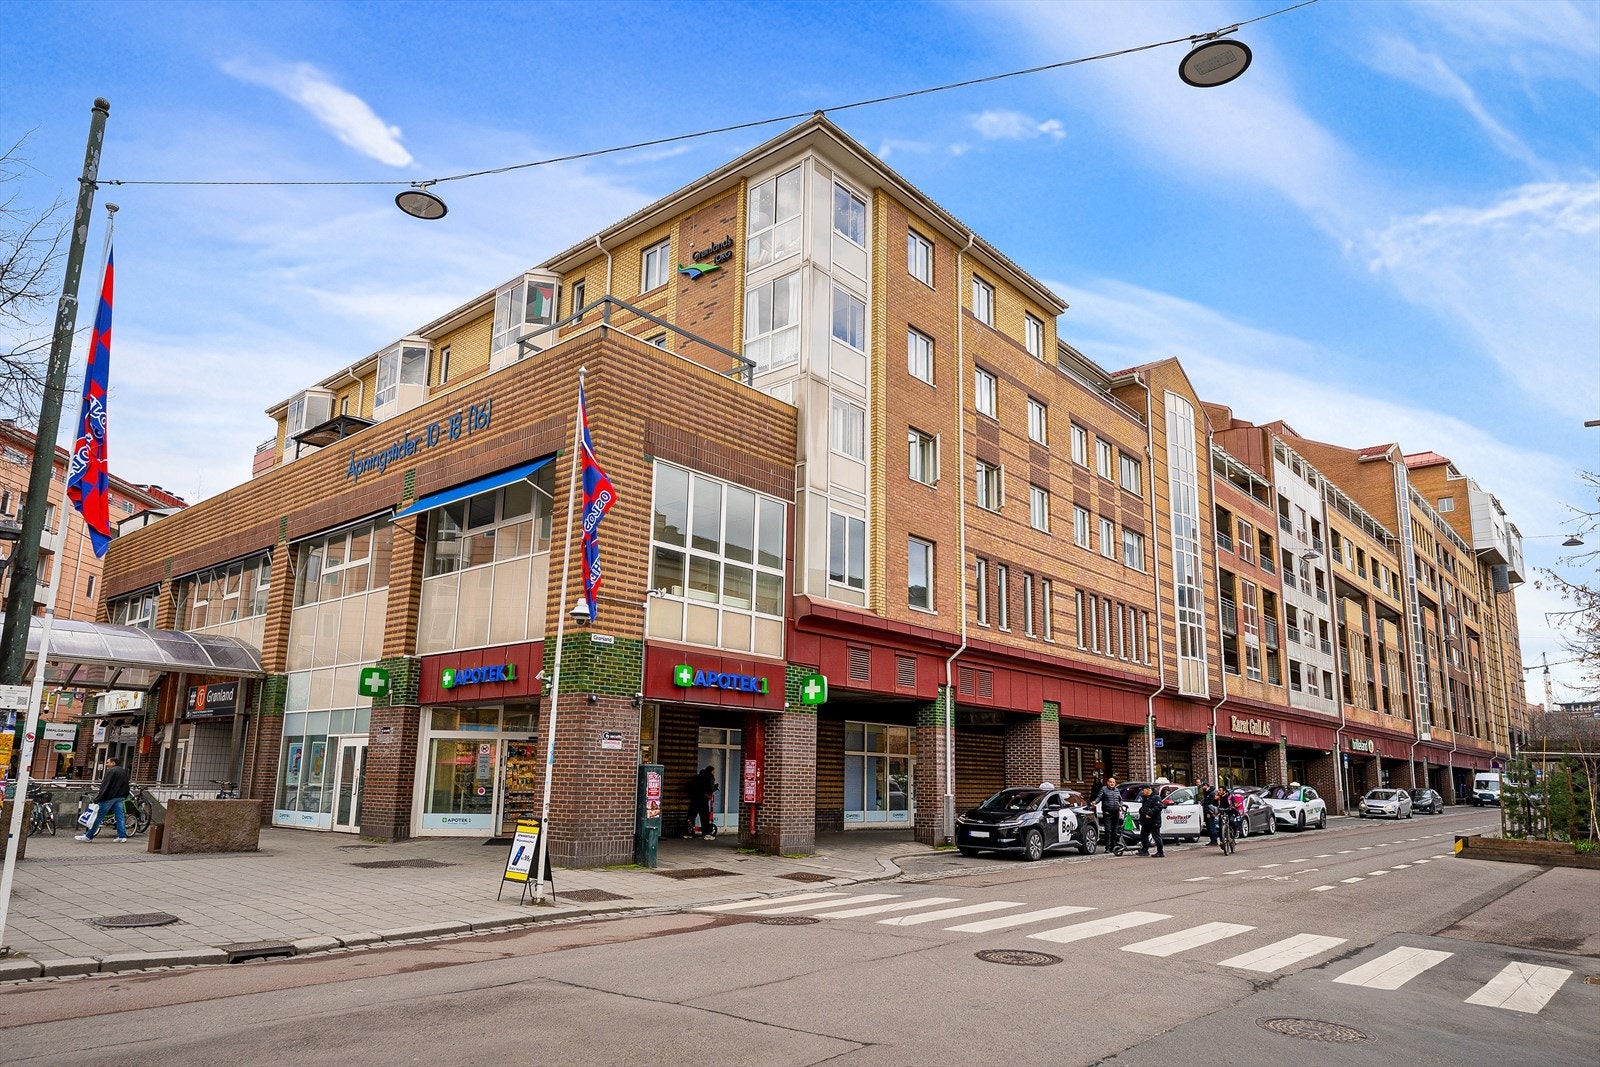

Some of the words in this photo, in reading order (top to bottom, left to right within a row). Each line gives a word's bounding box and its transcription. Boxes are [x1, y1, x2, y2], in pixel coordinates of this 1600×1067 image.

[346, 432, 422, 482] Åpningstider:
[467, 398, 493, 436] (16)
[454, 664, 506, 687] APOTEK
[694, 670, 760, 693] APOTEK
[206, 687, 235, 703] Grønland
